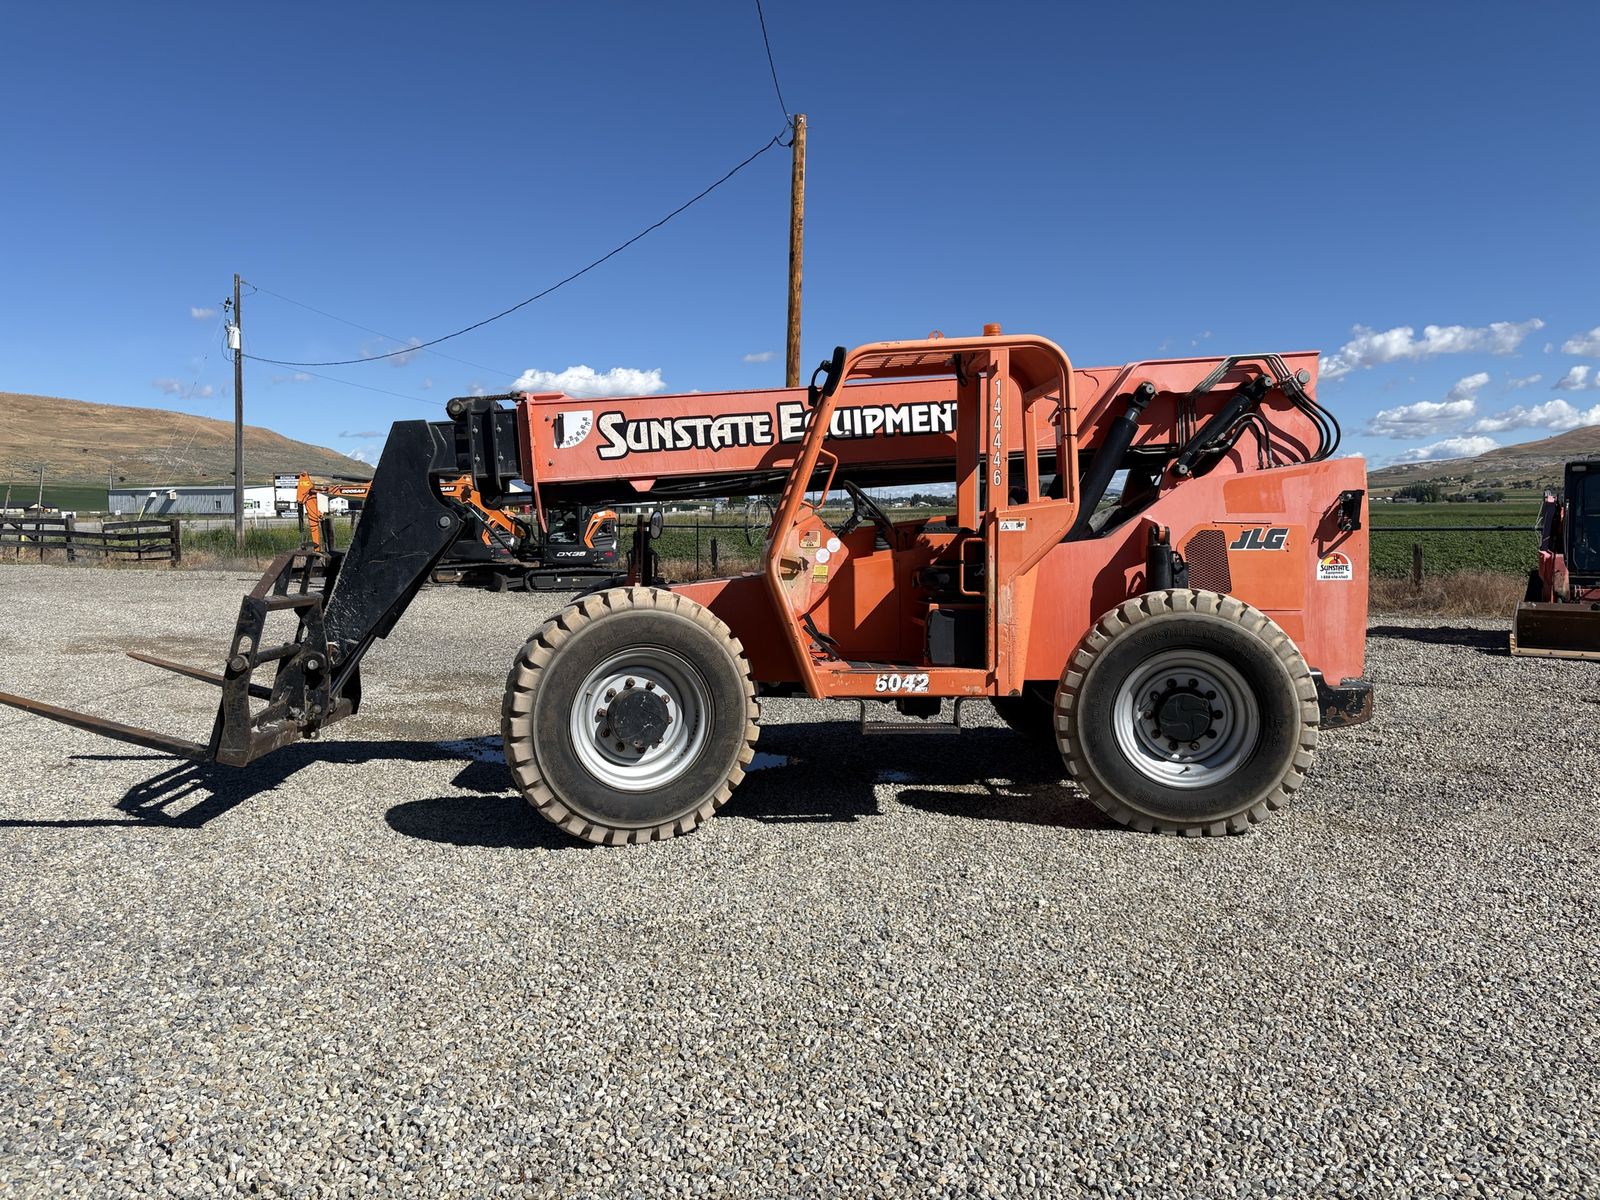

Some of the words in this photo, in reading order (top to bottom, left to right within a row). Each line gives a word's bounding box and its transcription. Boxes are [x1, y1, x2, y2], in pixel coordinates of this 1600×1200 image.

[597, 412, 773, 459] SUNSTATE
[778, 402, 957, 441] EUIPMEN
[993, 379, 1002, 486] 144446
[1229, 528, 1289, 550] JLG
[875, 674, 929, 693] 6042
